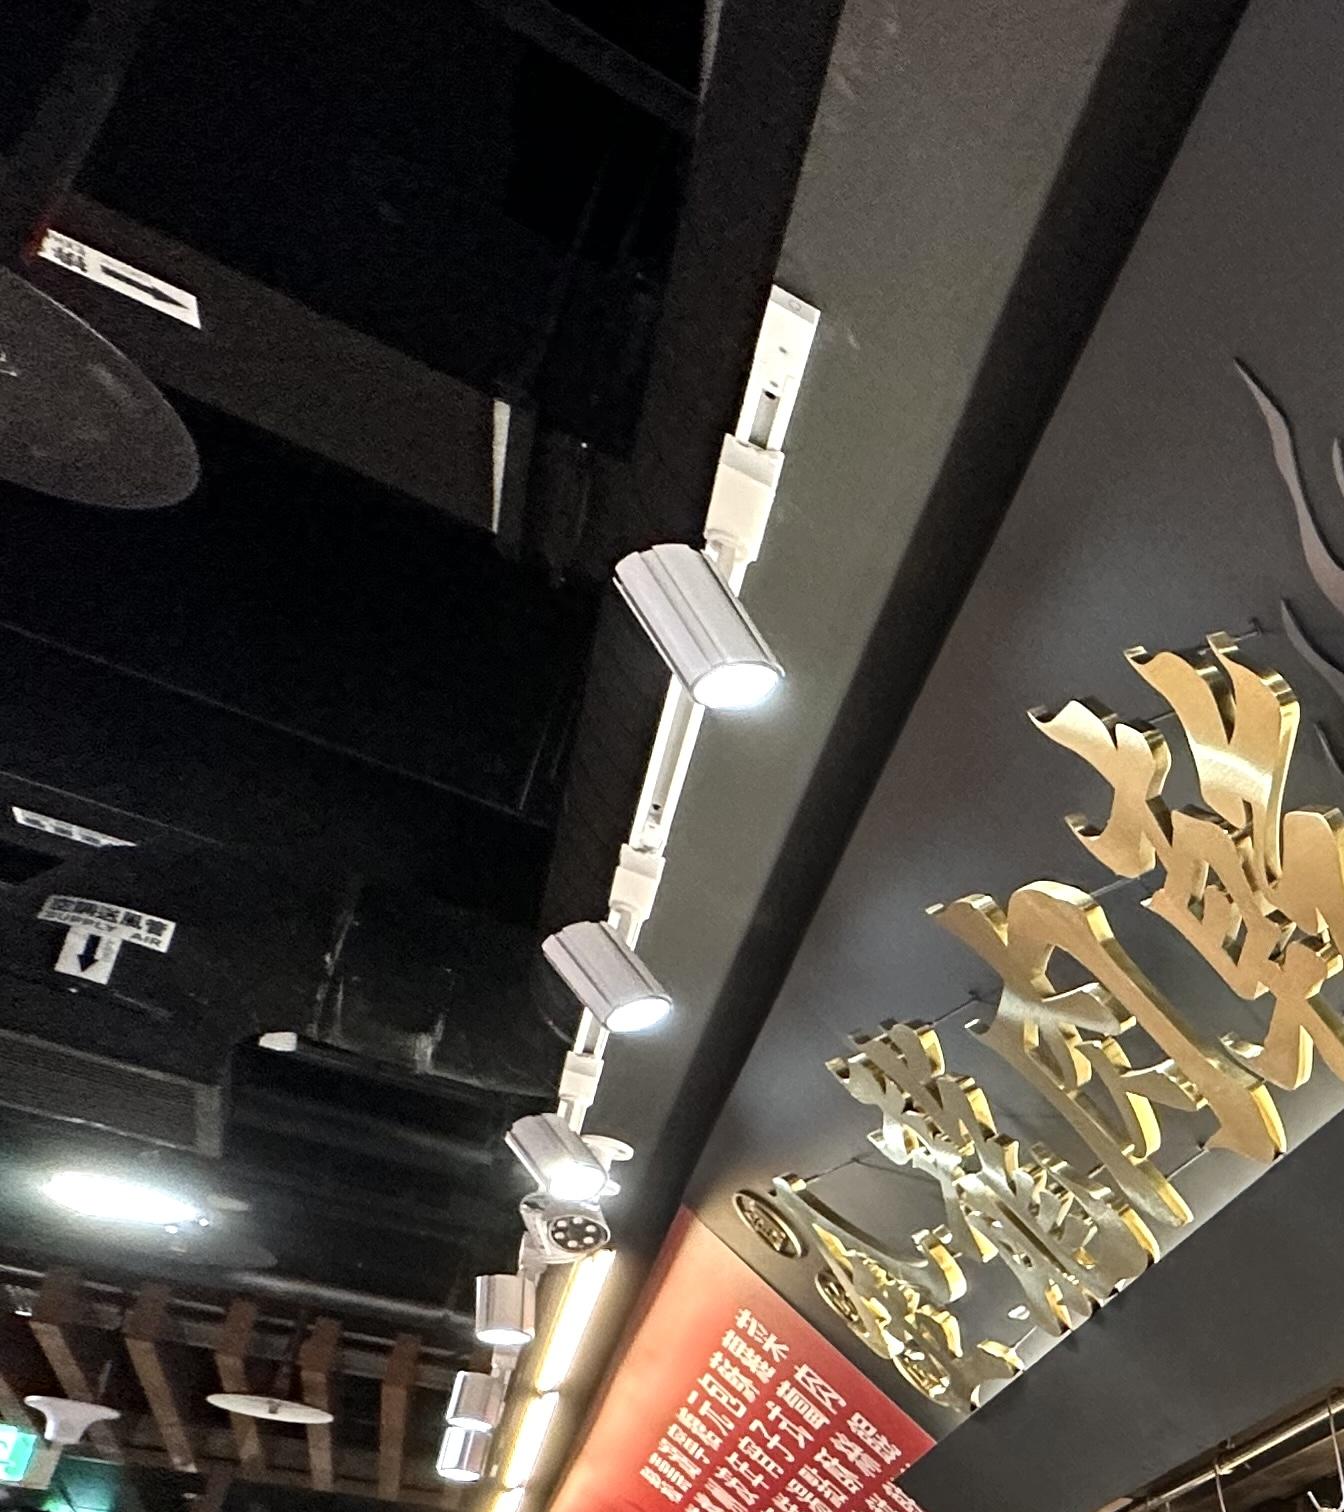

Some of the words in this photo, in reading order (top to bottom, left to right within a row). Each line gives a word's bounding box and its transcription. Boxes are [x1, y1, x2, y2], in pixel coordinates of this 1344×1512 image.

[129, 932, 163, 948] AIR
[734, 1307, 911, 1481] 菜肉餛
